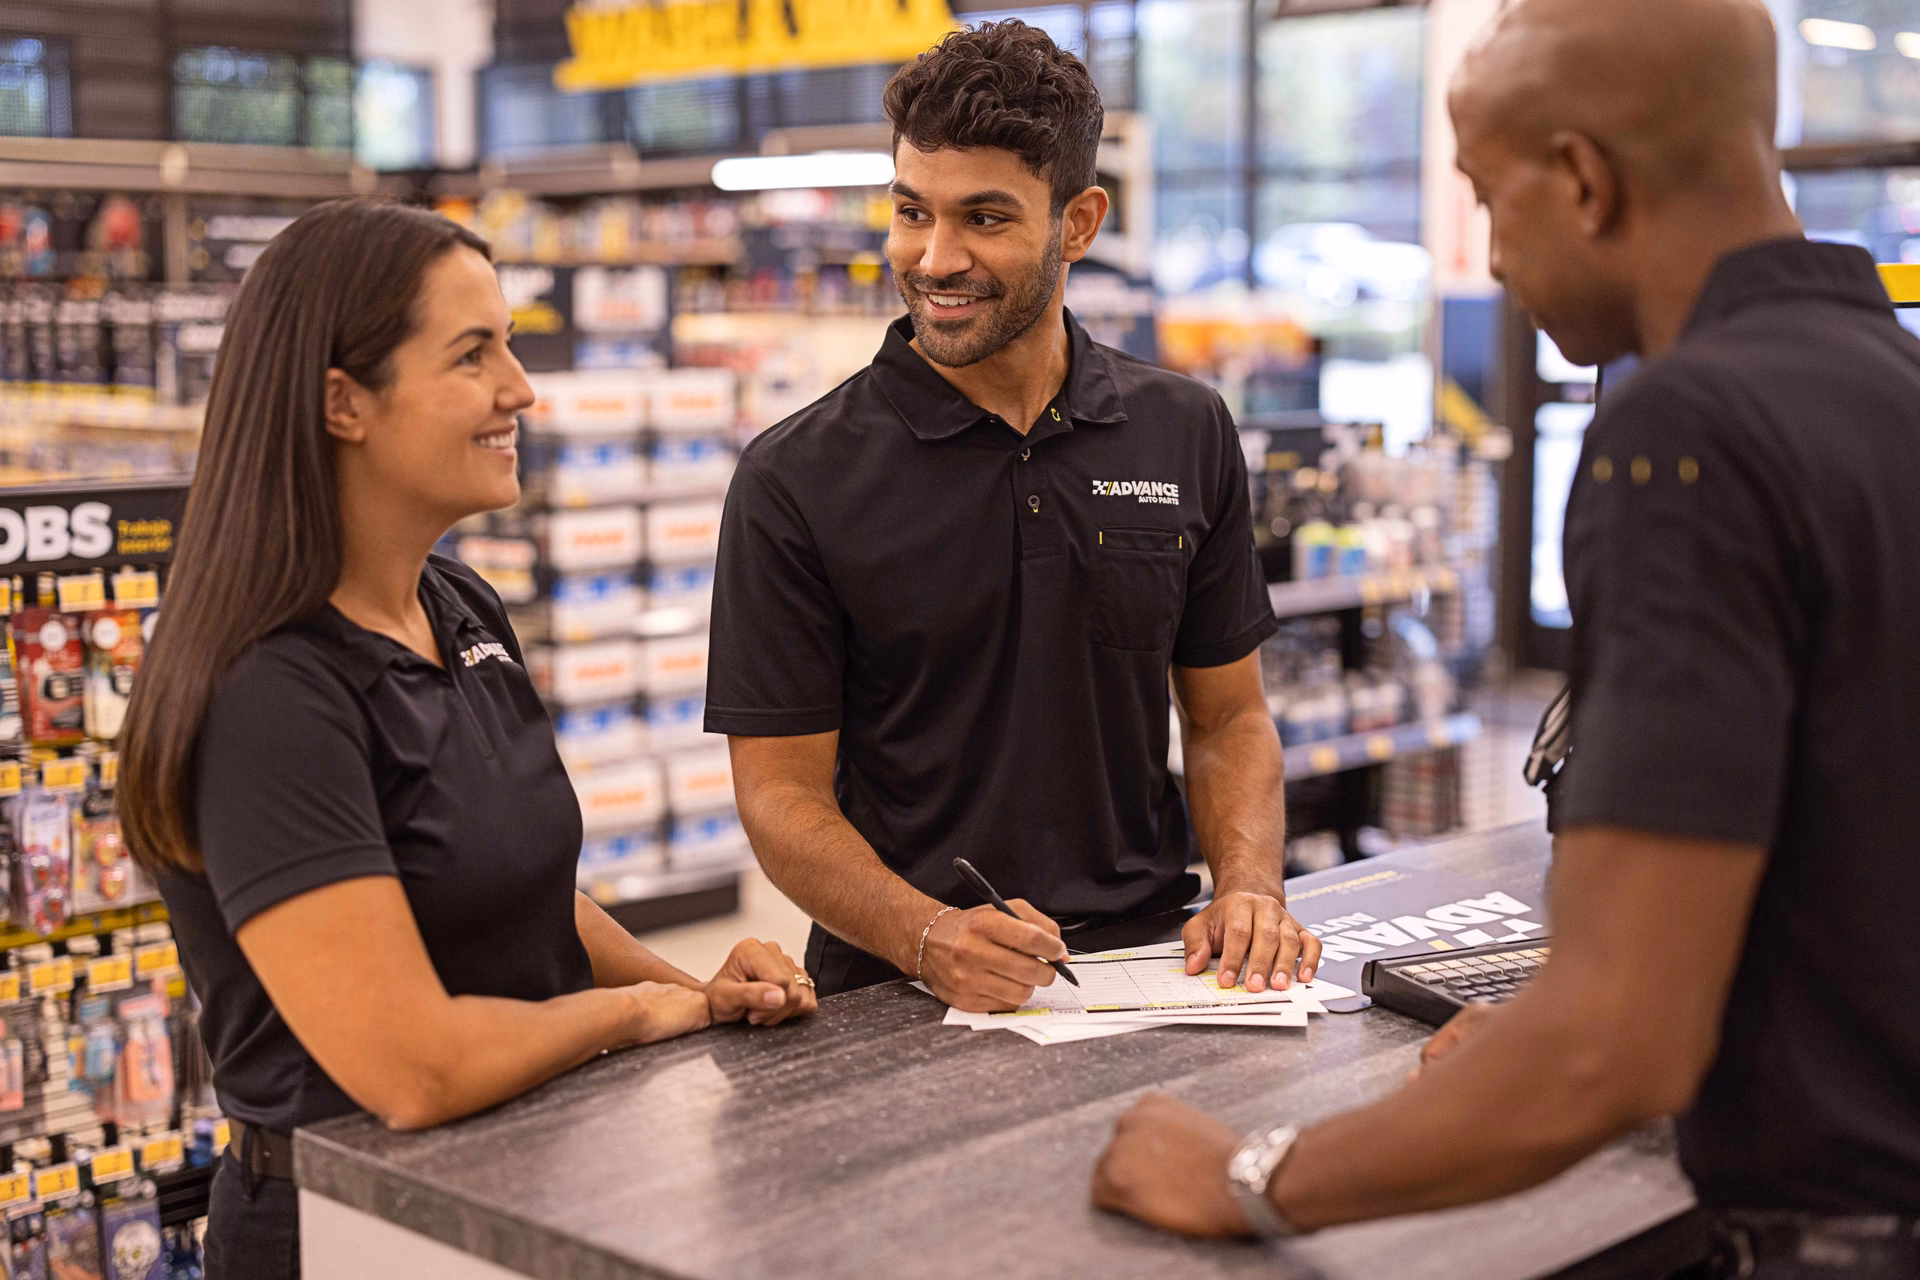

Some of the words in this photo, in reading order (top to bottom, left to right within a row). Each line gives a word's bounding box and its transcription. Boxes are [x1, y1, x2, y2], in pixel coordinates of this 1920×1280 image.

[1110, 481, 1179, 497] ADVANCE
[1158, 497, 1179, 505] PARTS
[1316, 890, 1532, 969] ADVAN
